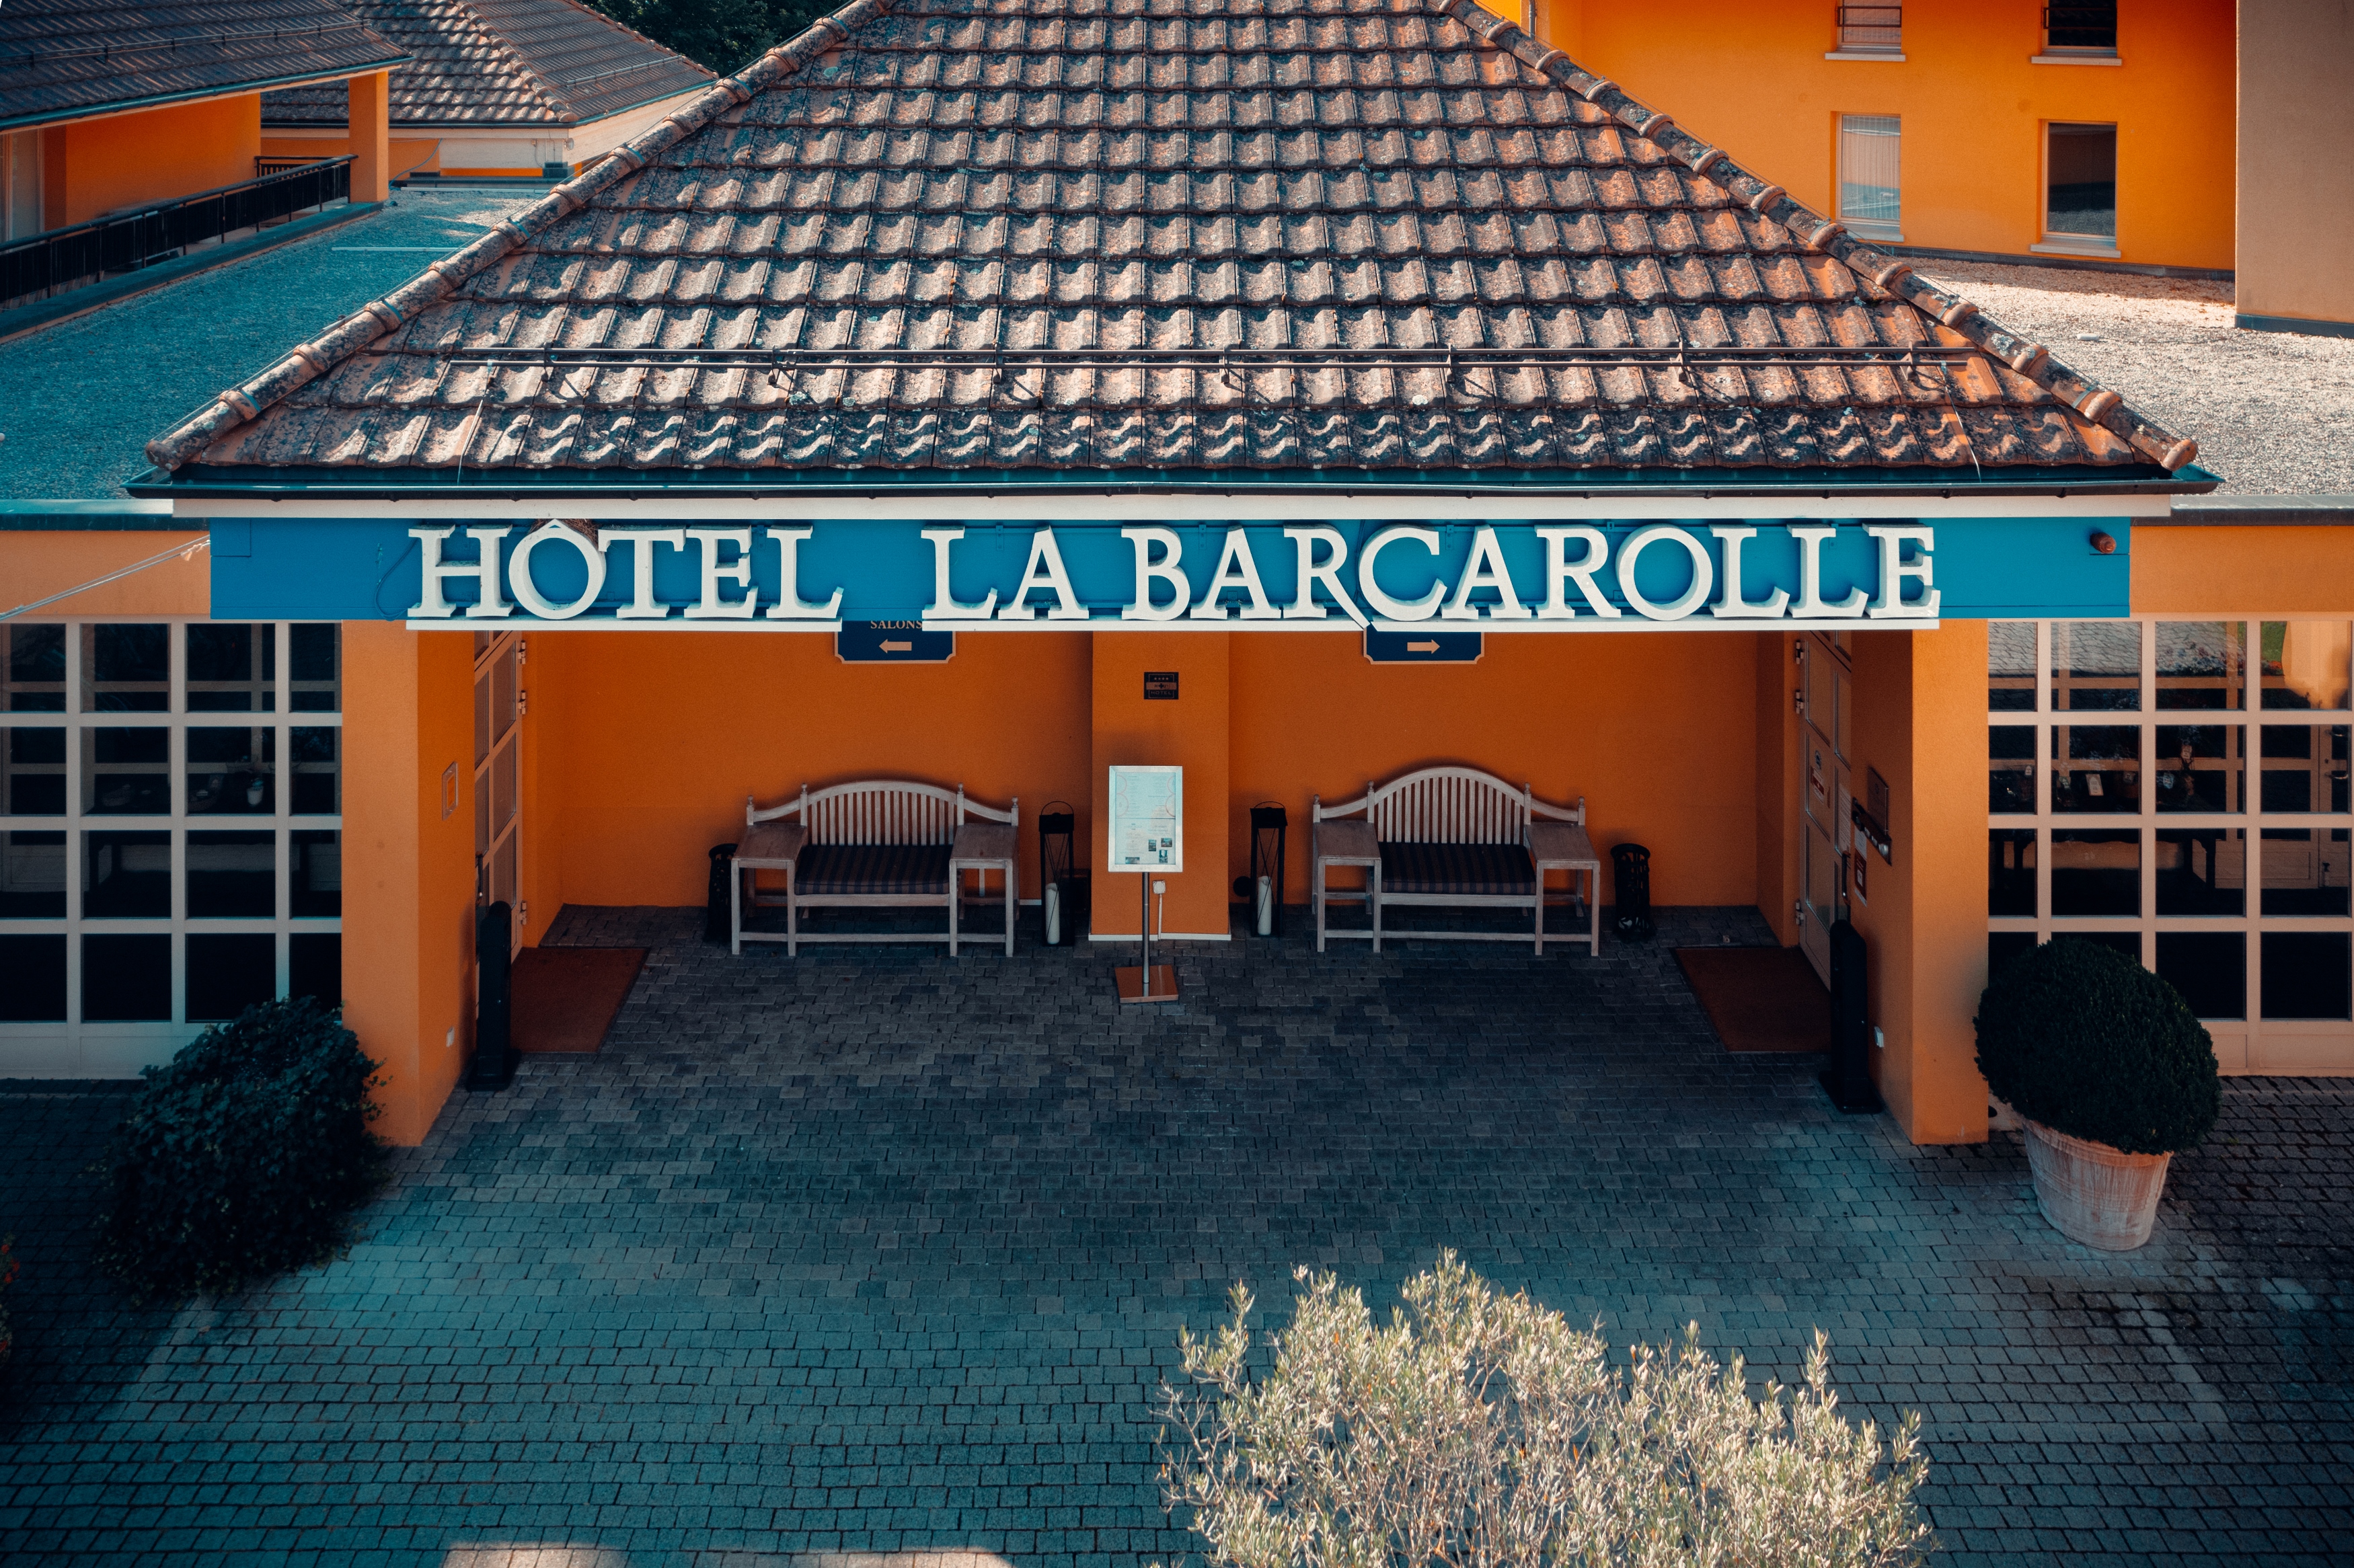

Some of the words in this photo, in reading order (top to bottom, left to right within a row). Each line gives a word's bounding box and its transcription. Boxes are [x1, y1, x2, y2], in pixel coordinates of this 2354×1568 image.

[408, 518, 843, 620] HÔTEL
[921, 524, 1090, 620] LA
[1121, 524, 1941, 629] BARCAROLLE
[870, 620, 923, 629] SALONS
